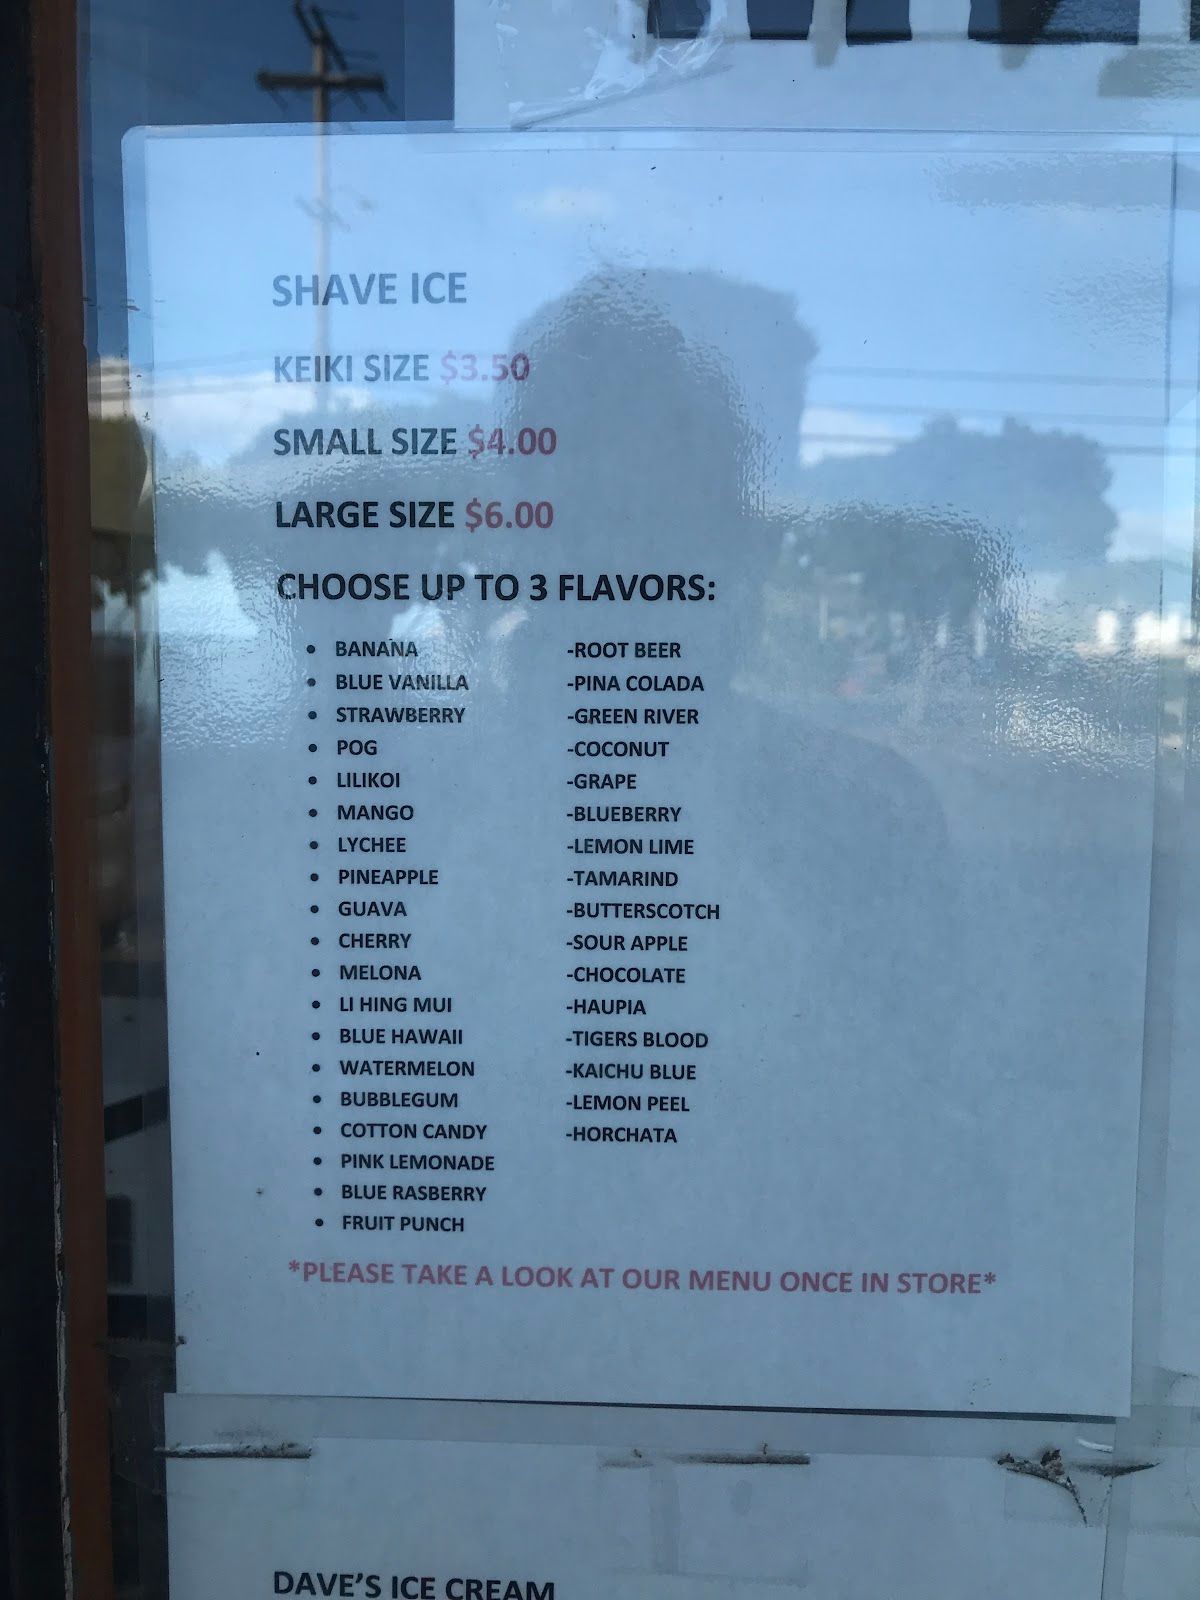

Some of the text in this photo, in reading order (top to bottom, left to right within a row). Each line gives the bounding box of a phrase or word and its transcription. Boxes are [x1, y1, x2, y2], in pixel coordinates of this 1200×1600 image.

[273, 272, 467, 307] SHAVE ICE
[275, 351, 530, 386] KEIKI SIZE $3.50
[274, 424, 556, 458] SMALL SIZE $4.00
[276, 498, 553, 533] LARGE SIZE $6.00
[277, 573, 715, 601] CHOOSE UP TO 3 FLAVORS:
[336, 641, 418, 657] BANANA
[568, 642, 680, 658] -ROOT BEER
[336, 674, 469, 690] BLUE VANILLA
[568, 676, 704, 691] -PINA COLADA
[337, 707, 465, 723] STRAWBERRY
[568, 708, 698, 724] -GREEN RIVER
[338, 740, 377, 755] POG
[568, 741, 669, 757] -COCONUT
[338, 773, 399, 788] LILIKOI
[567, 774, 636, 789] -GRAPE
[338, 805, 414, 820] MANGO
[567, 806, 681, 822] -BLUEBERRY
[339, 837, 406, 852] LYCHEE
[568, 839, 694, 854] -LEMON LIME
[339, 870, 438, 884] PINEAPPLE
[567, 871, 678, 886] -TAMARIND
[339, 901, 407, 916] GUAVA
[567, 903, 719, 919] -BUTTERSCOTCH
[339, 933, 411, 948] CHERRY
[567, 935, 687, 951] -SOUR APPLE
[340, 965, 421, 980] MELONA
[567, 967, 685, 983] -CHOCOLATE
[340, 997, 451, 1012] LI HING MUI
[567, 999, 646, 1015] -HAUPIA
[340, 1029, 462, 1044] BLUE HAWAII
[566, 1031, 708, 1048] -TIGERS BLOOD
[340, 1060, 474, 1076] WATERMELON
[566, 1063, 696, 1080] -KAICHU BLUE
[341, 1092, 458, 1107] BUBBLEGUM
[567, 1095, 689, 1111] -LEMON PEEL
[341, 1123, 487, 1139] COTTON CANDY
[566, 1127, 677, 1143] -HORCHATA
[342, 1154, 494, 1171] PINK LEMONADE
[342, 1185, 486, 1201] BLUE RASBERRY
[343, 1215, 464, 1232] FRUIT PUNCH
[402, 1264, 467, 1285] TAKE
[475, 1262, 493, 1286] A
[502, 1266, 573, 1287] LOOK
[580, 1268, 614, 1288] AT
[623, 1267, 680, 1290] OUR
[690, 1270, 771, 1291] MENU
[780, 1269, 852, 1292] ONCE
[862, 1273, 891, 1293] IN
[391, 1576, 435, 1599] ICE
[445, 1578, 555, 1600] CREAM
